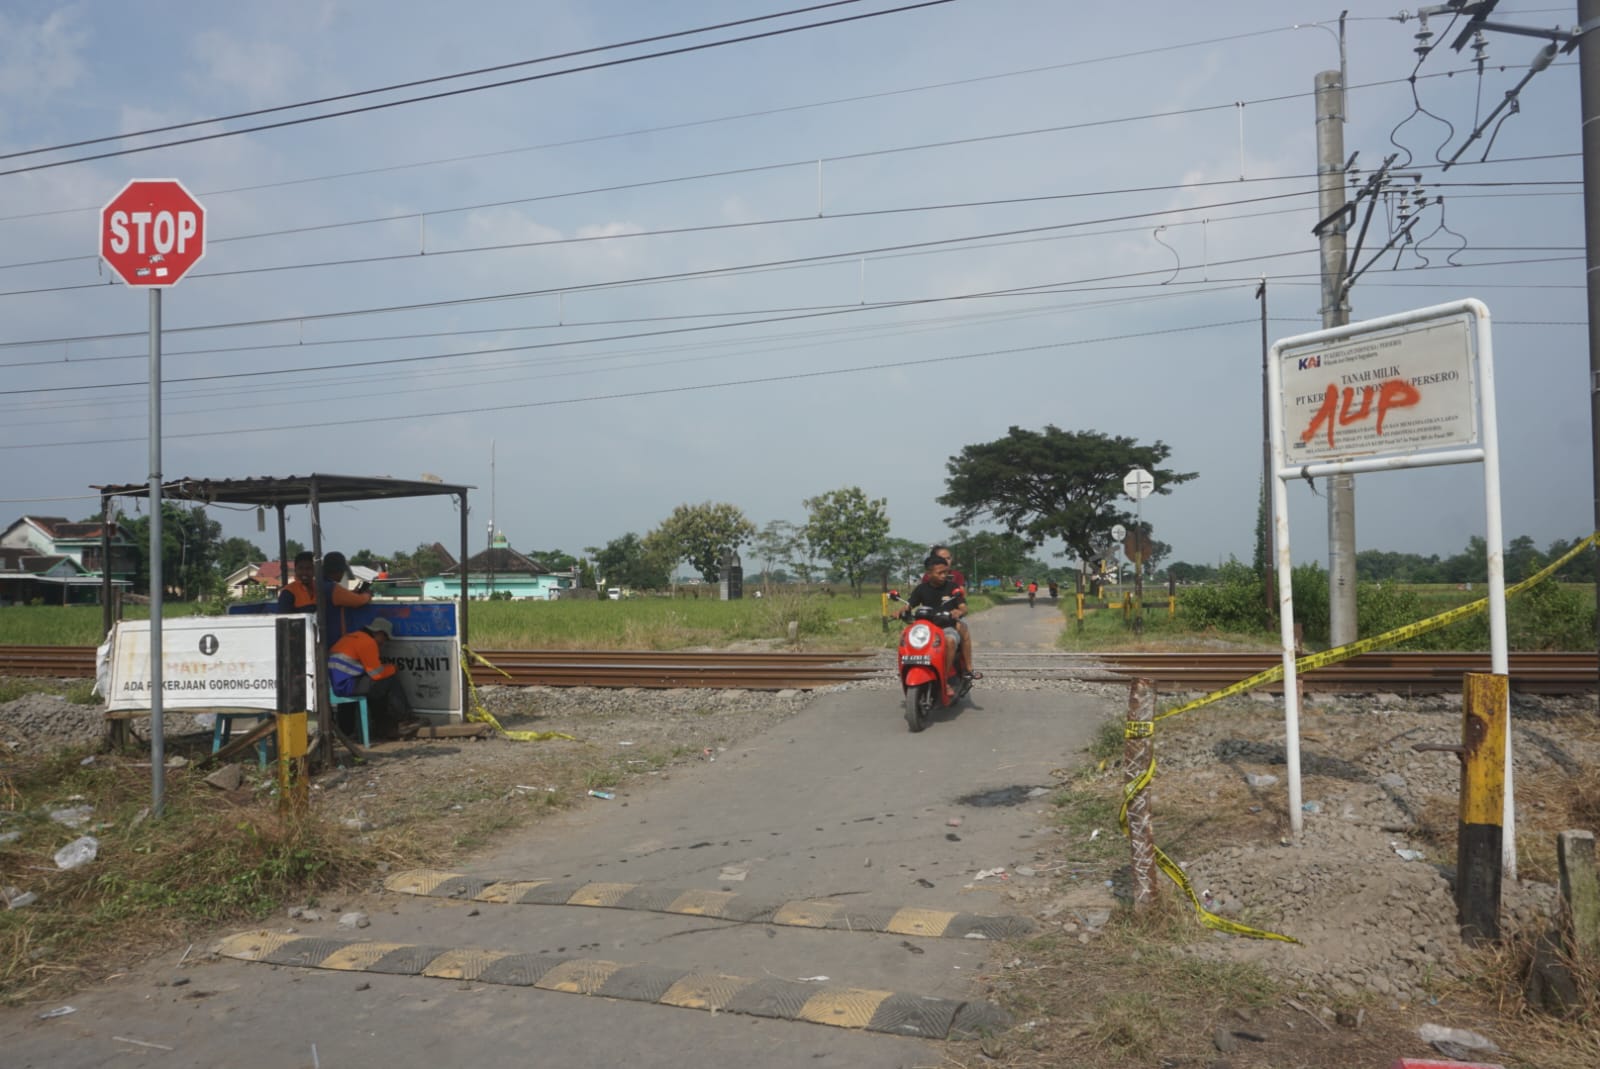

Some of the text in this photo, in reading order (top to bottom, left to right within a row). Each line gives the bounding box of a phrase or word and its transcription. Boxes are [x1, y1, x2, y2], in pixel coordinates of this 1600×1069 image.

[110, 210, 197, 255] STOP
[1298, 355, 1321, 371] KAI
[1341, 364, 1400, 385] TANAH MILIK
[124, 679, 278, 692] ADA PKERJAAN GORONG-GOR
